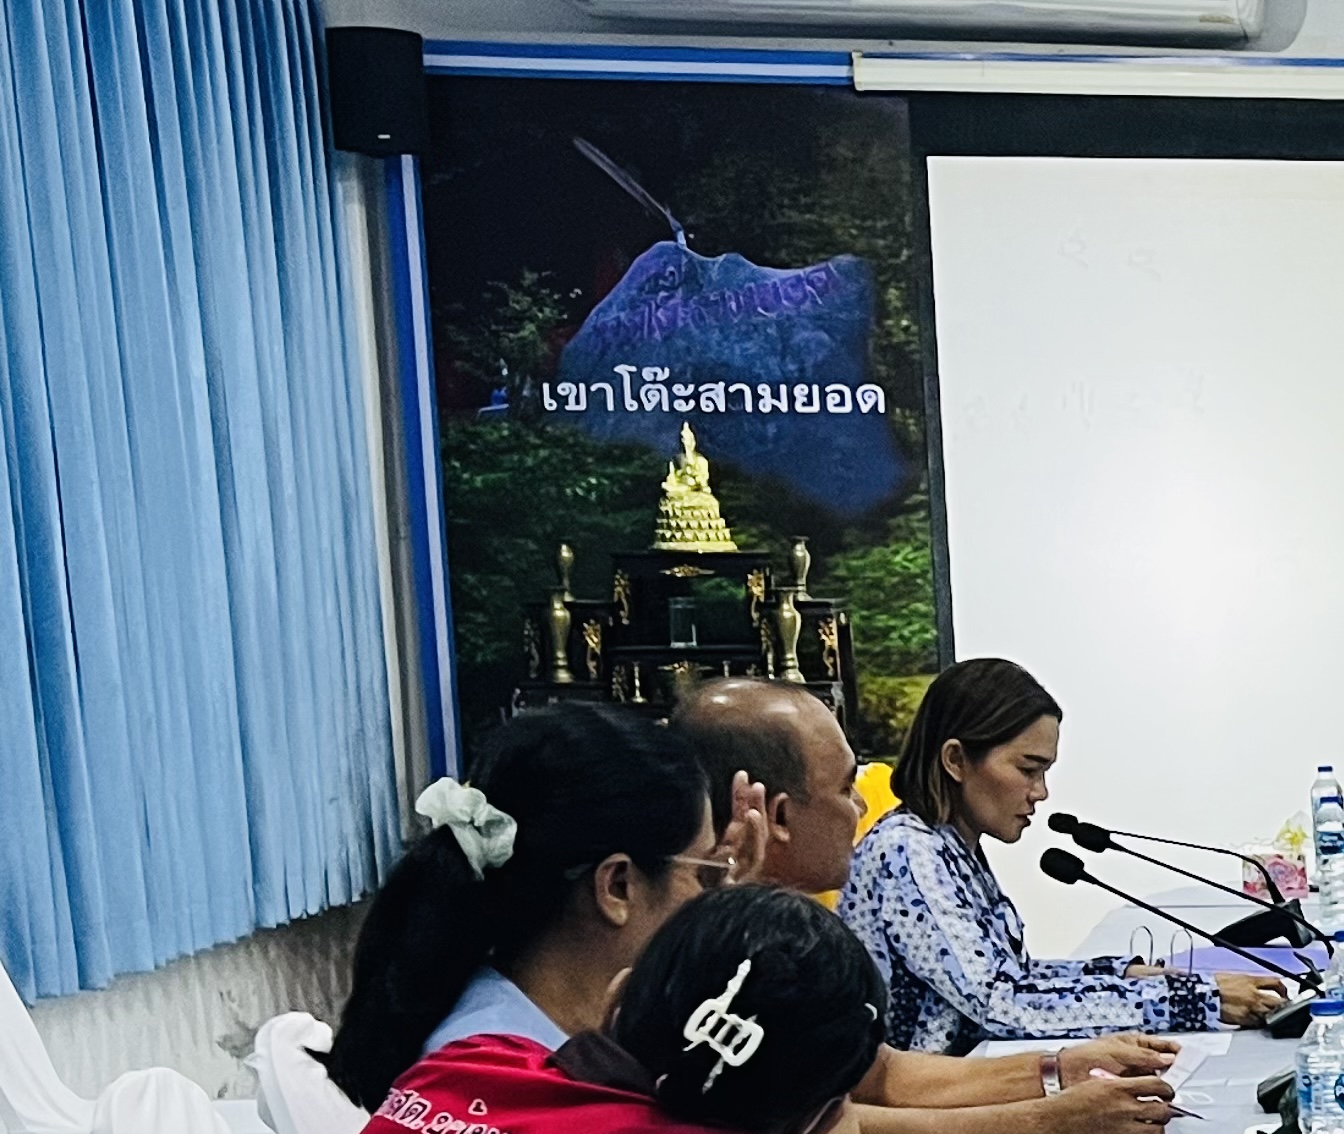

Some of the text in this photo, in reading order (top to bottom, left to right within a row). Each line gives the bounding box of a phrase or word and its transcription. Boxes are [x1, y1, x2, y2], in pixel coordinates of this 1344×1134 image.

[542, 364, 886, 413] เขาโต๊ะสามยอด
